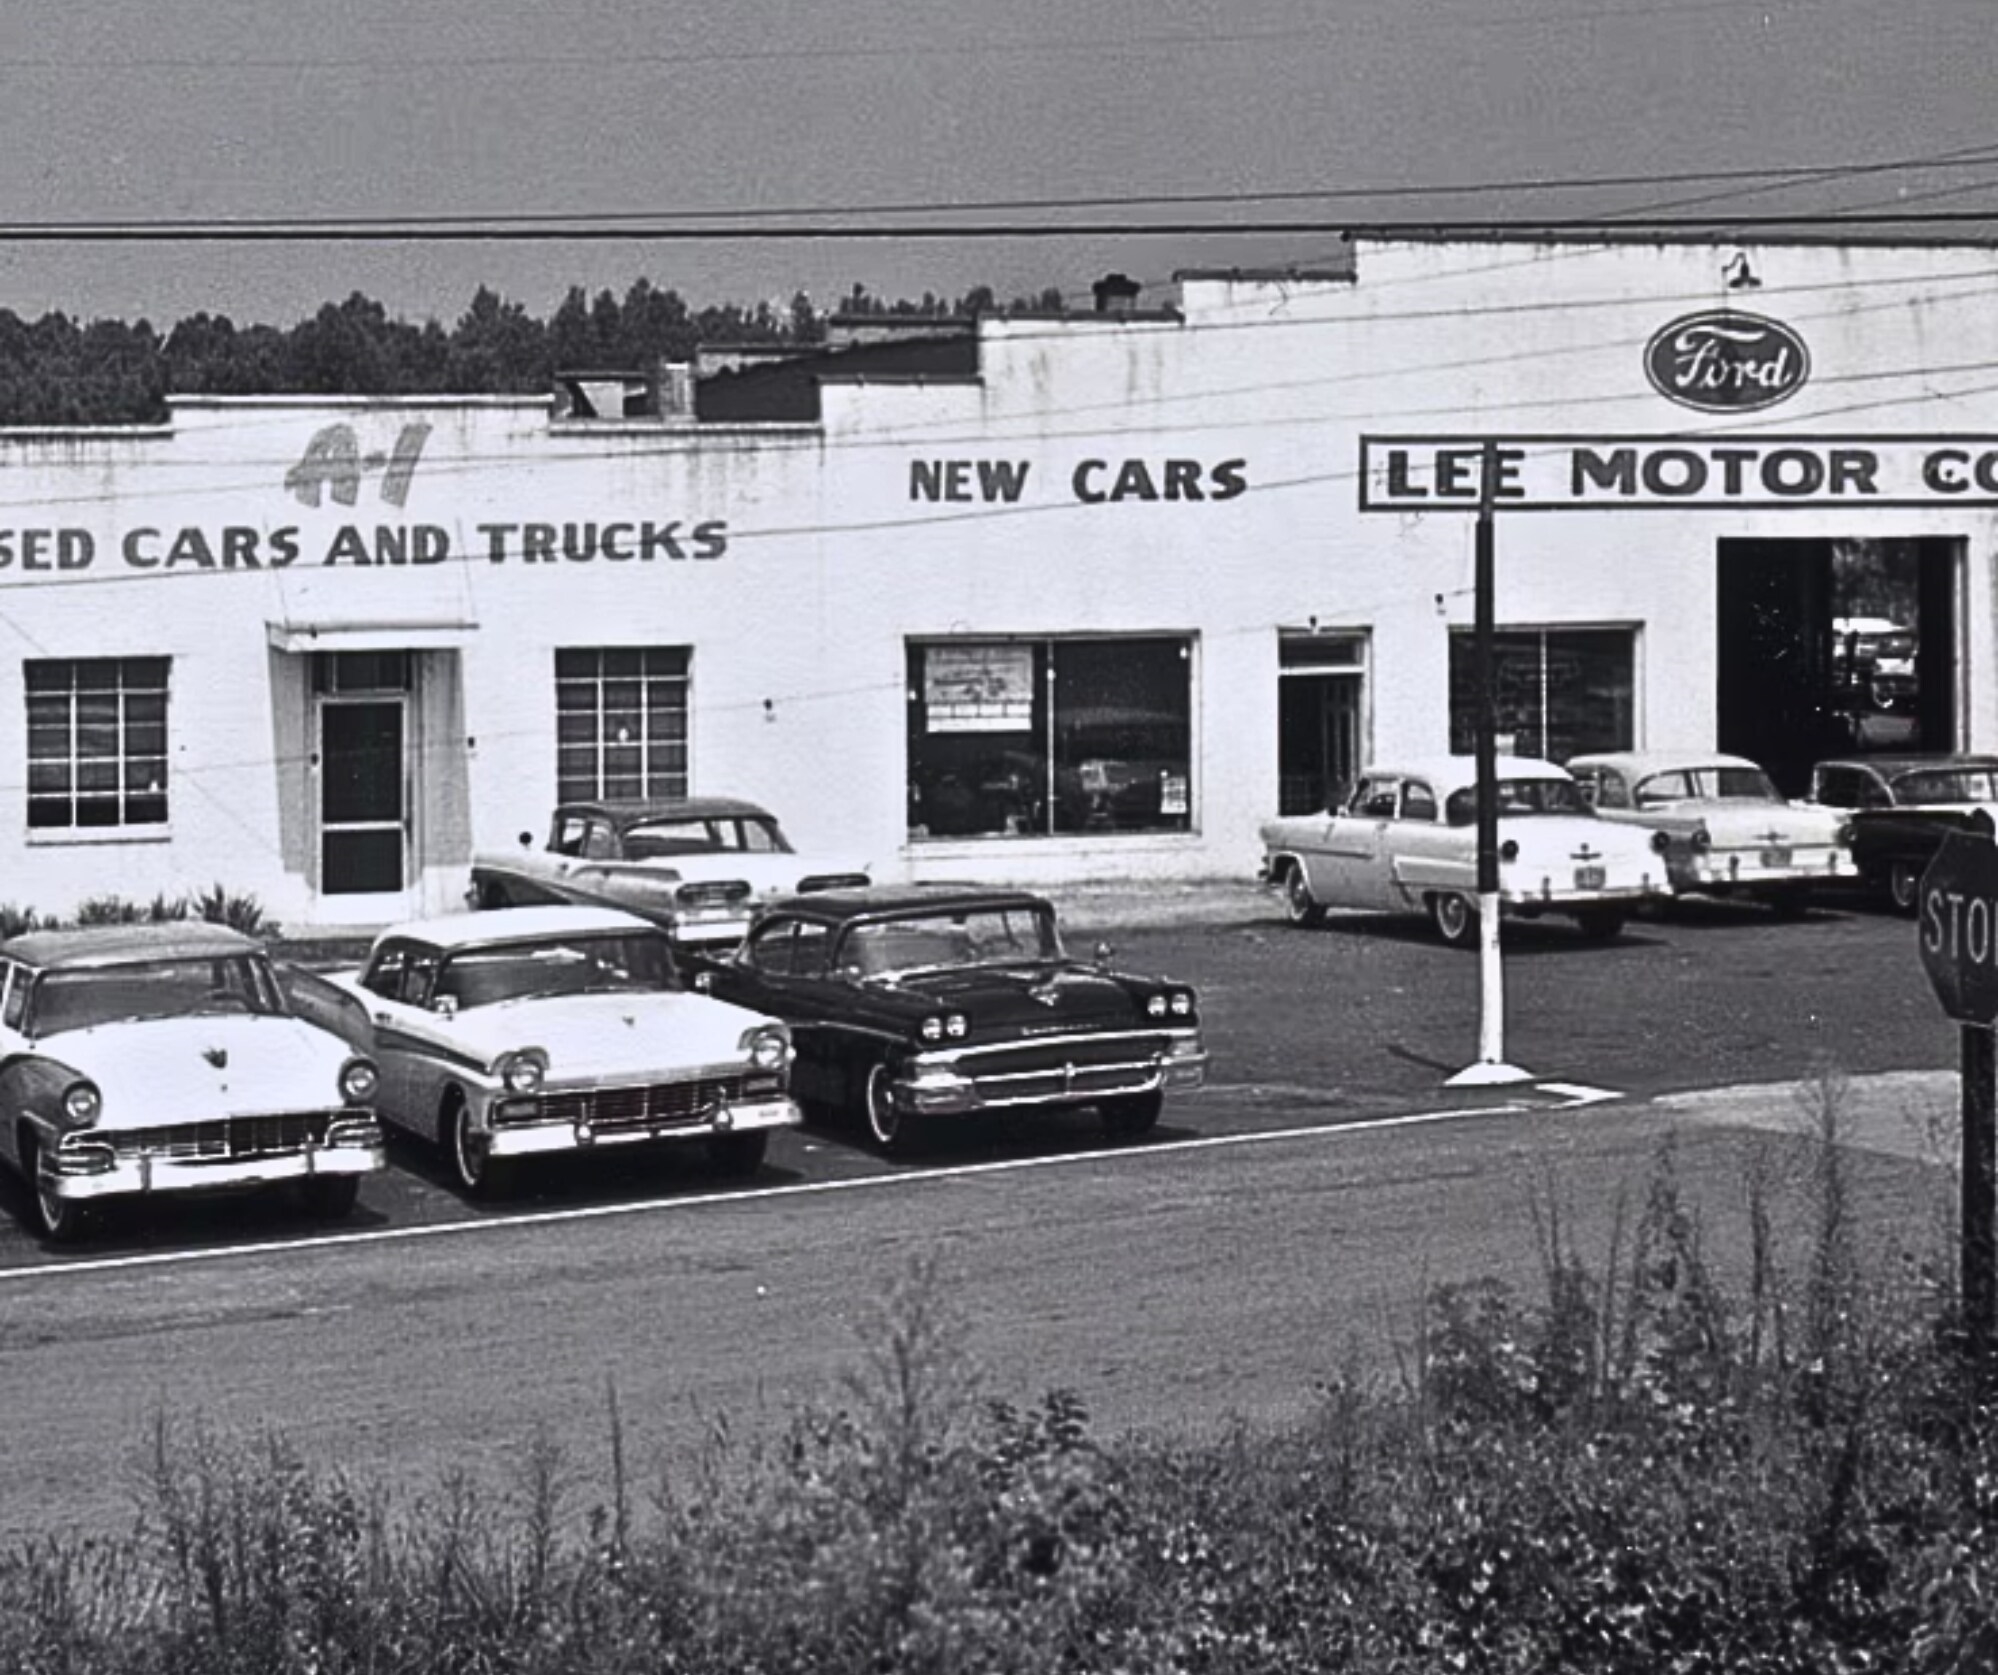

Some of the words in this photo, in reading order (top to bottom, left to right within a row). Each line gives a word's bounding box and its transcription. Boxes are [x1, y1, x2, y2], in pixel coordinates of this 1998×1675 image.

[1675, 325, 1793, 388] Ford
[284, 423, 433, 507] A-1
[909, 459, 1030, 502] NEW
[1072, 458, 1247, 503] CARS
[1388, 449, 1525, 497] LEE
[1571, 448, 1878, 496] MOTOR
[122, 524, 300, 570] CARS
[322, 523, 449, 566] AND
[476, 520, 728, 564] TRUCKS
[1924, 888, 1998, 967] STO
